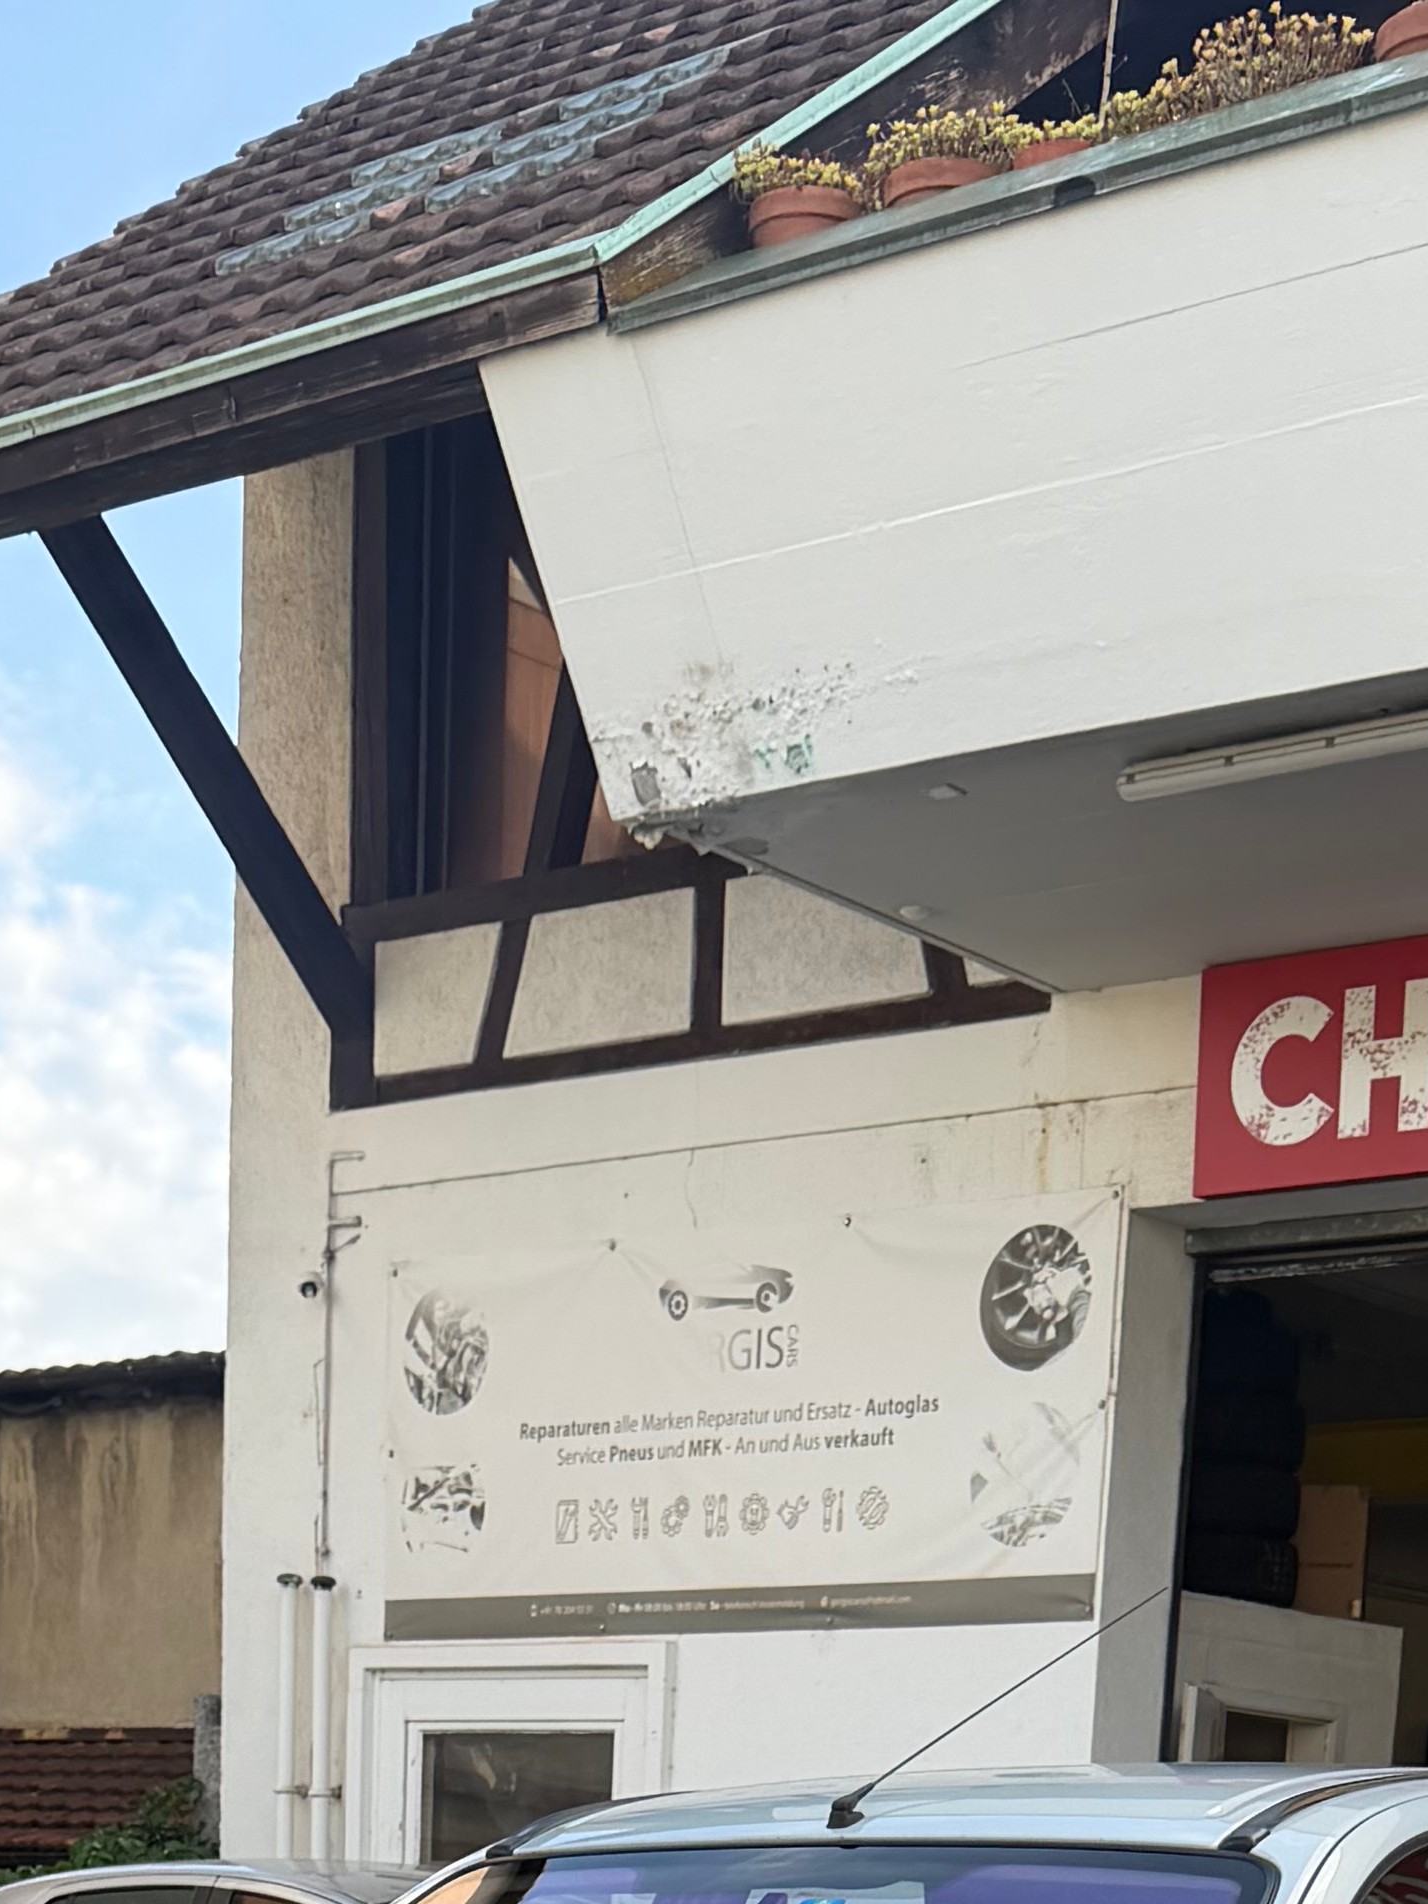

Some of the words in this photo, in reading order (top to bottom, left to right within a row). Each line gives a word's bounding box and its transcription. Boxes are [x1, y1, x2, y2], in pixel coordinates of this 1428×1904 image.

[786, 1324, 799, 1368] CARS
[519, 1420, 611, 1443] Reparaturen
[613, 1415, 638, 1434] alle
[641, 1412, 694, 1431] Marken
[697, 1407, 770, 1431] Reparatur
[773, 1402, 803, 1423] und
[807, 1402, 852, 1421] Ersatz
[864, 1394, 940, 1419] Autoglas
[556, 1447, 606, 1466] Service
[609, 1444, 654, 1463] Pneus
[657, 1441, 685, 1460] und
[688, 1438, 723, 1458] MFK
[734, 1436, 756, 1455] An
[759, 1433, 789, 1453] und
[792, 1433, 820, 1452] Aus
[824, 1426, 894, 1449] verkauft
